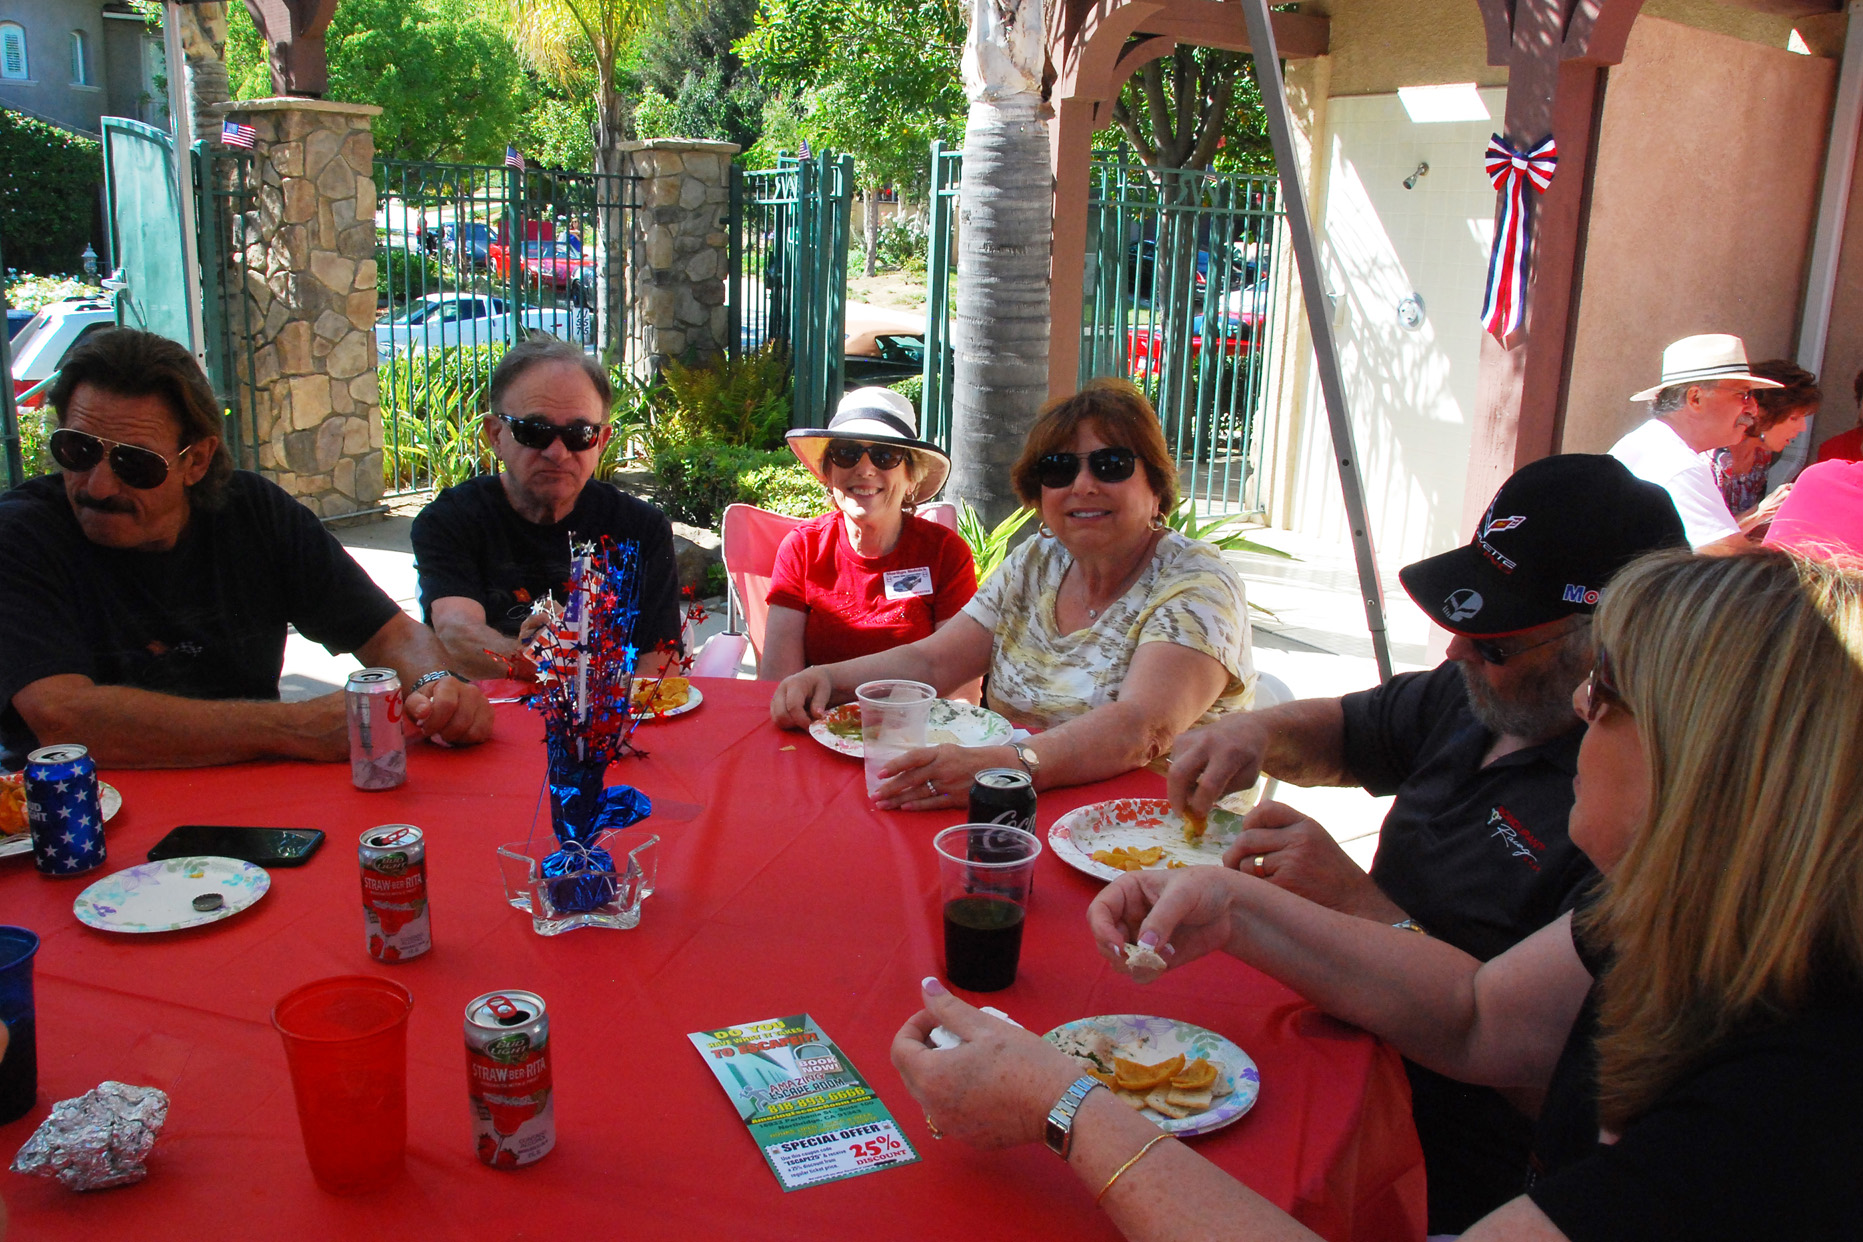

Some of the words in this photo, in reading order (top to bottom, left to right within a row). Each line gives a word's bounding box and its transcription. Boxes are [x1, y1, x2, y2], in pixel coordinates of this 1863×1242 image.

[713, 1028, 743, 1039] DO
[748, 1021, 786, 1033] YOU
[707, 1039, 732, 1048] HAVE
[734, 1034, 761, 1043] WHAT
[711, 1047, 735, 1059] TO
[737, 1033, 820, 1055] ESCAPE!?!
[800, 1056, 838, 1067] BOOK
[802, 1061, 840, 1073] NOW!
[768, 1072, 826, 1093] AMAZING
[768, 1085, 811, 1099] ESCAPE
[813, 1078, 845, 1092] ROOM
[767, 1086, 866, 1114] 818-893-6666
[781, 1133, 839, 1152] SPECIAL
[840, 1124, 881, 1139] OFFER
[849, 1134, 901, 1158] 25%
[855, 1149, 907, 1165] DISCOUNT
